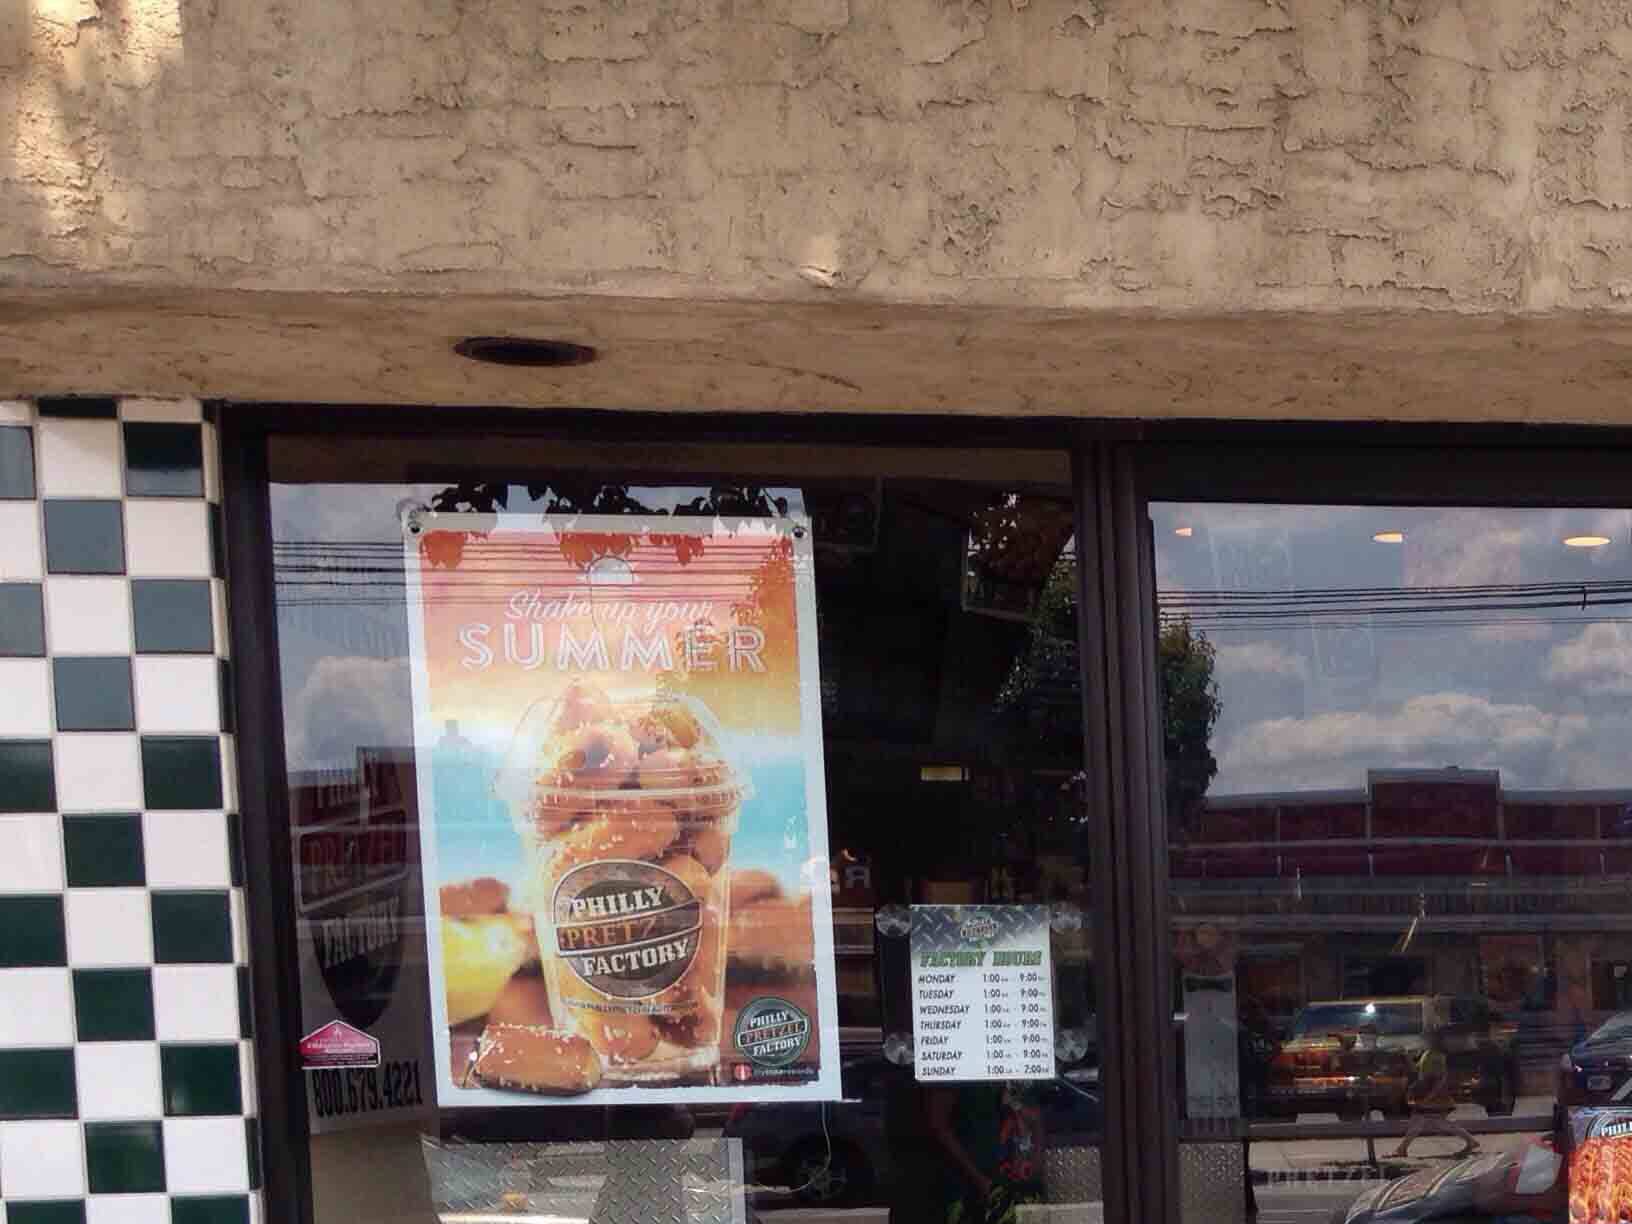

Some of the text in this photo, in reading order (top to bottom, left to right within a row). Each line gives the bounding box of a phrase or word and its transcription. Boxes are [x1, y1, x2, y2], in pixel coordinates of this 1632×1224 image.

[460, 622, 768, 673] SUMMER
[570, 886, 665, 917] PHILLY
[580, 938, 689, 977] FACTORY
[749, 1010, 789, 1028] PHILLY
[753, 1037, 802, 1056] FACTORY
